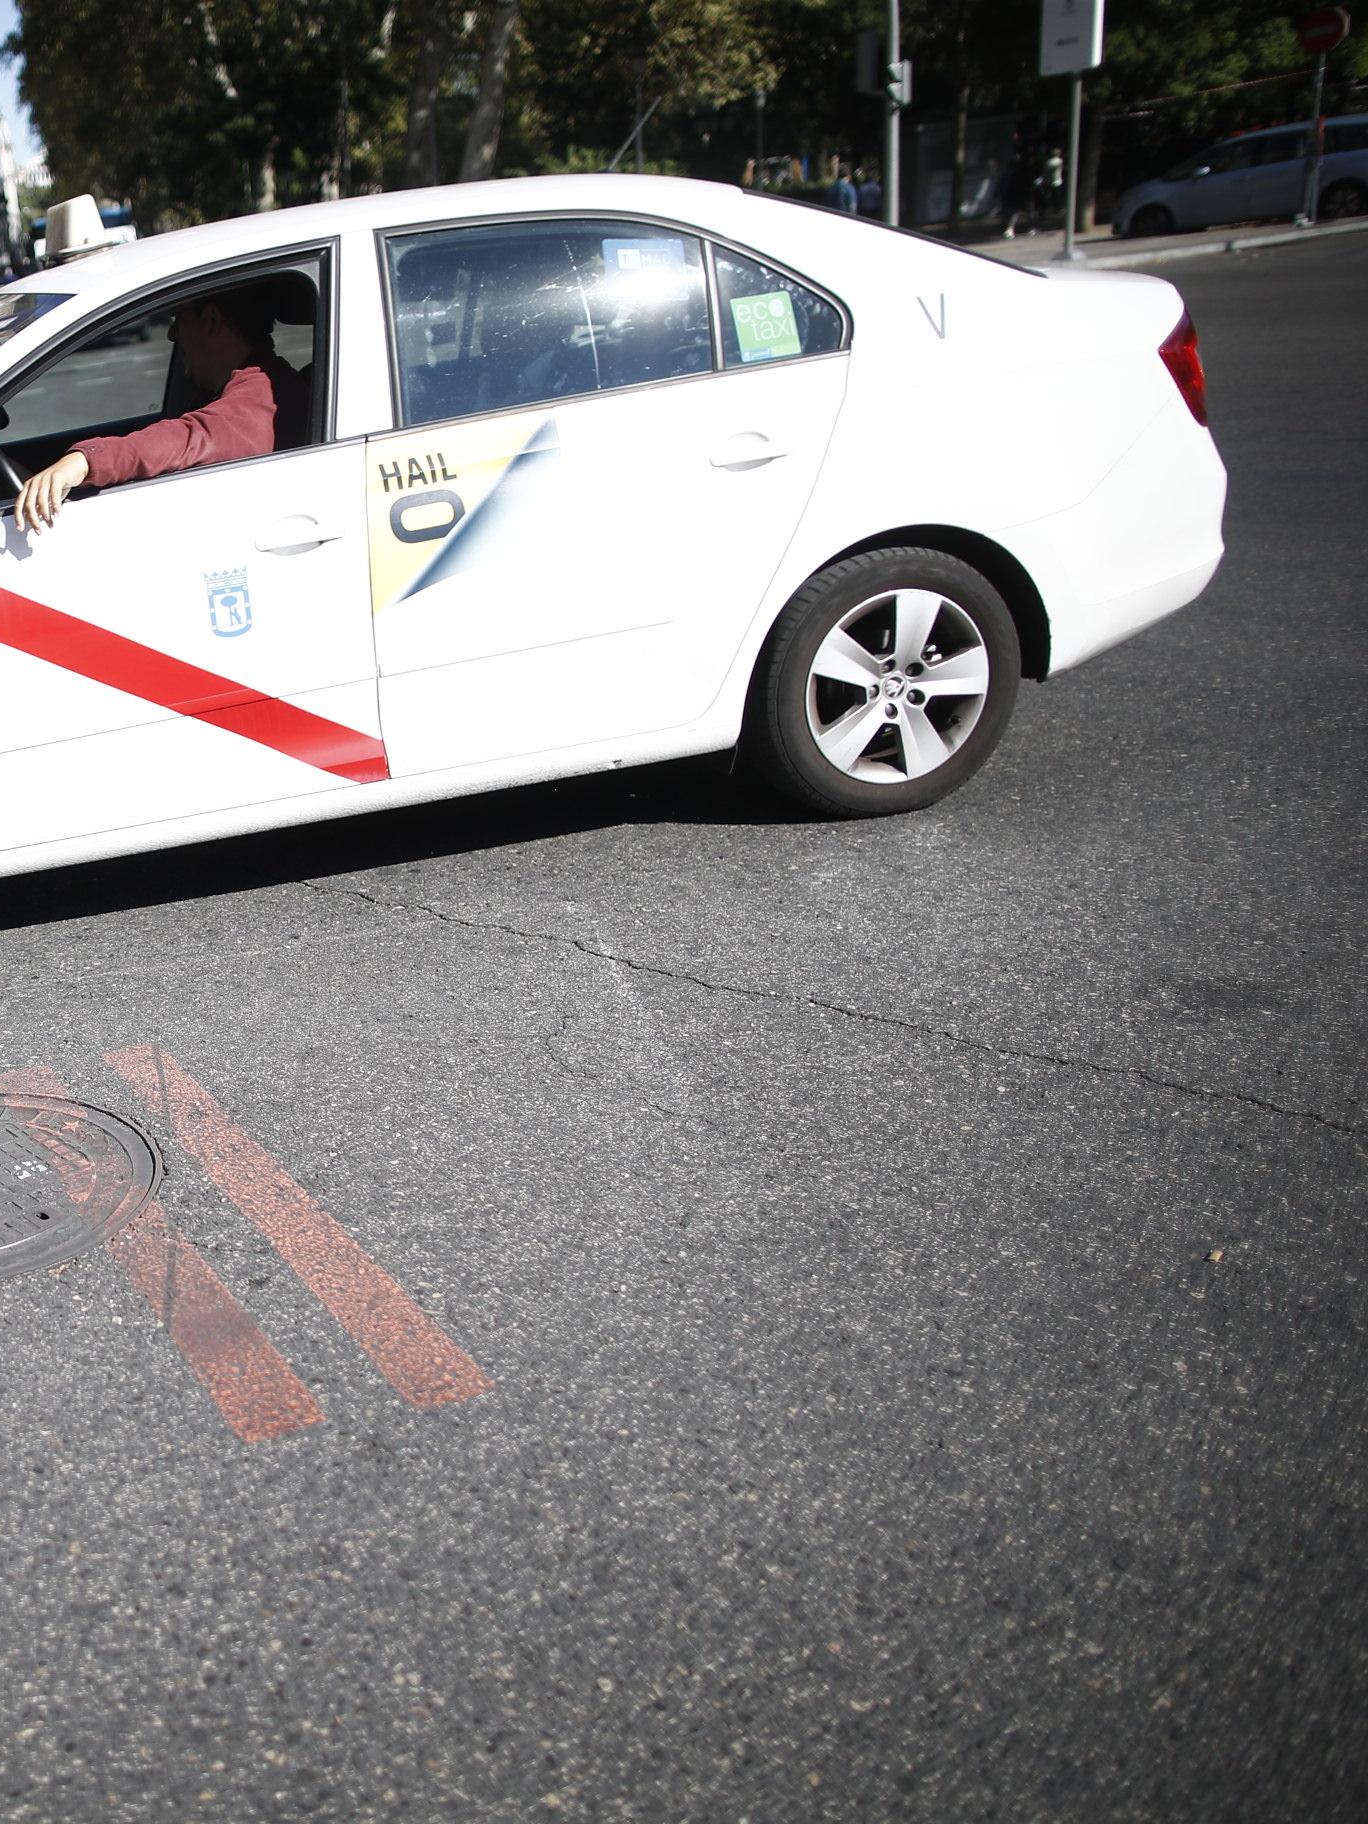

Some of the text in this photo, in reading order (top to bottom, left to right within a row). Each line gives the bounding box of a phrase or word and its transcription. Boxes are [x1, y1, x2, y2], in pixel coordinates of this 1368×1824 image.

[735, 299, 786, 323] eco
[750, 313, 796, 341] taxi
[378, 453, 457, 492] HAIL
